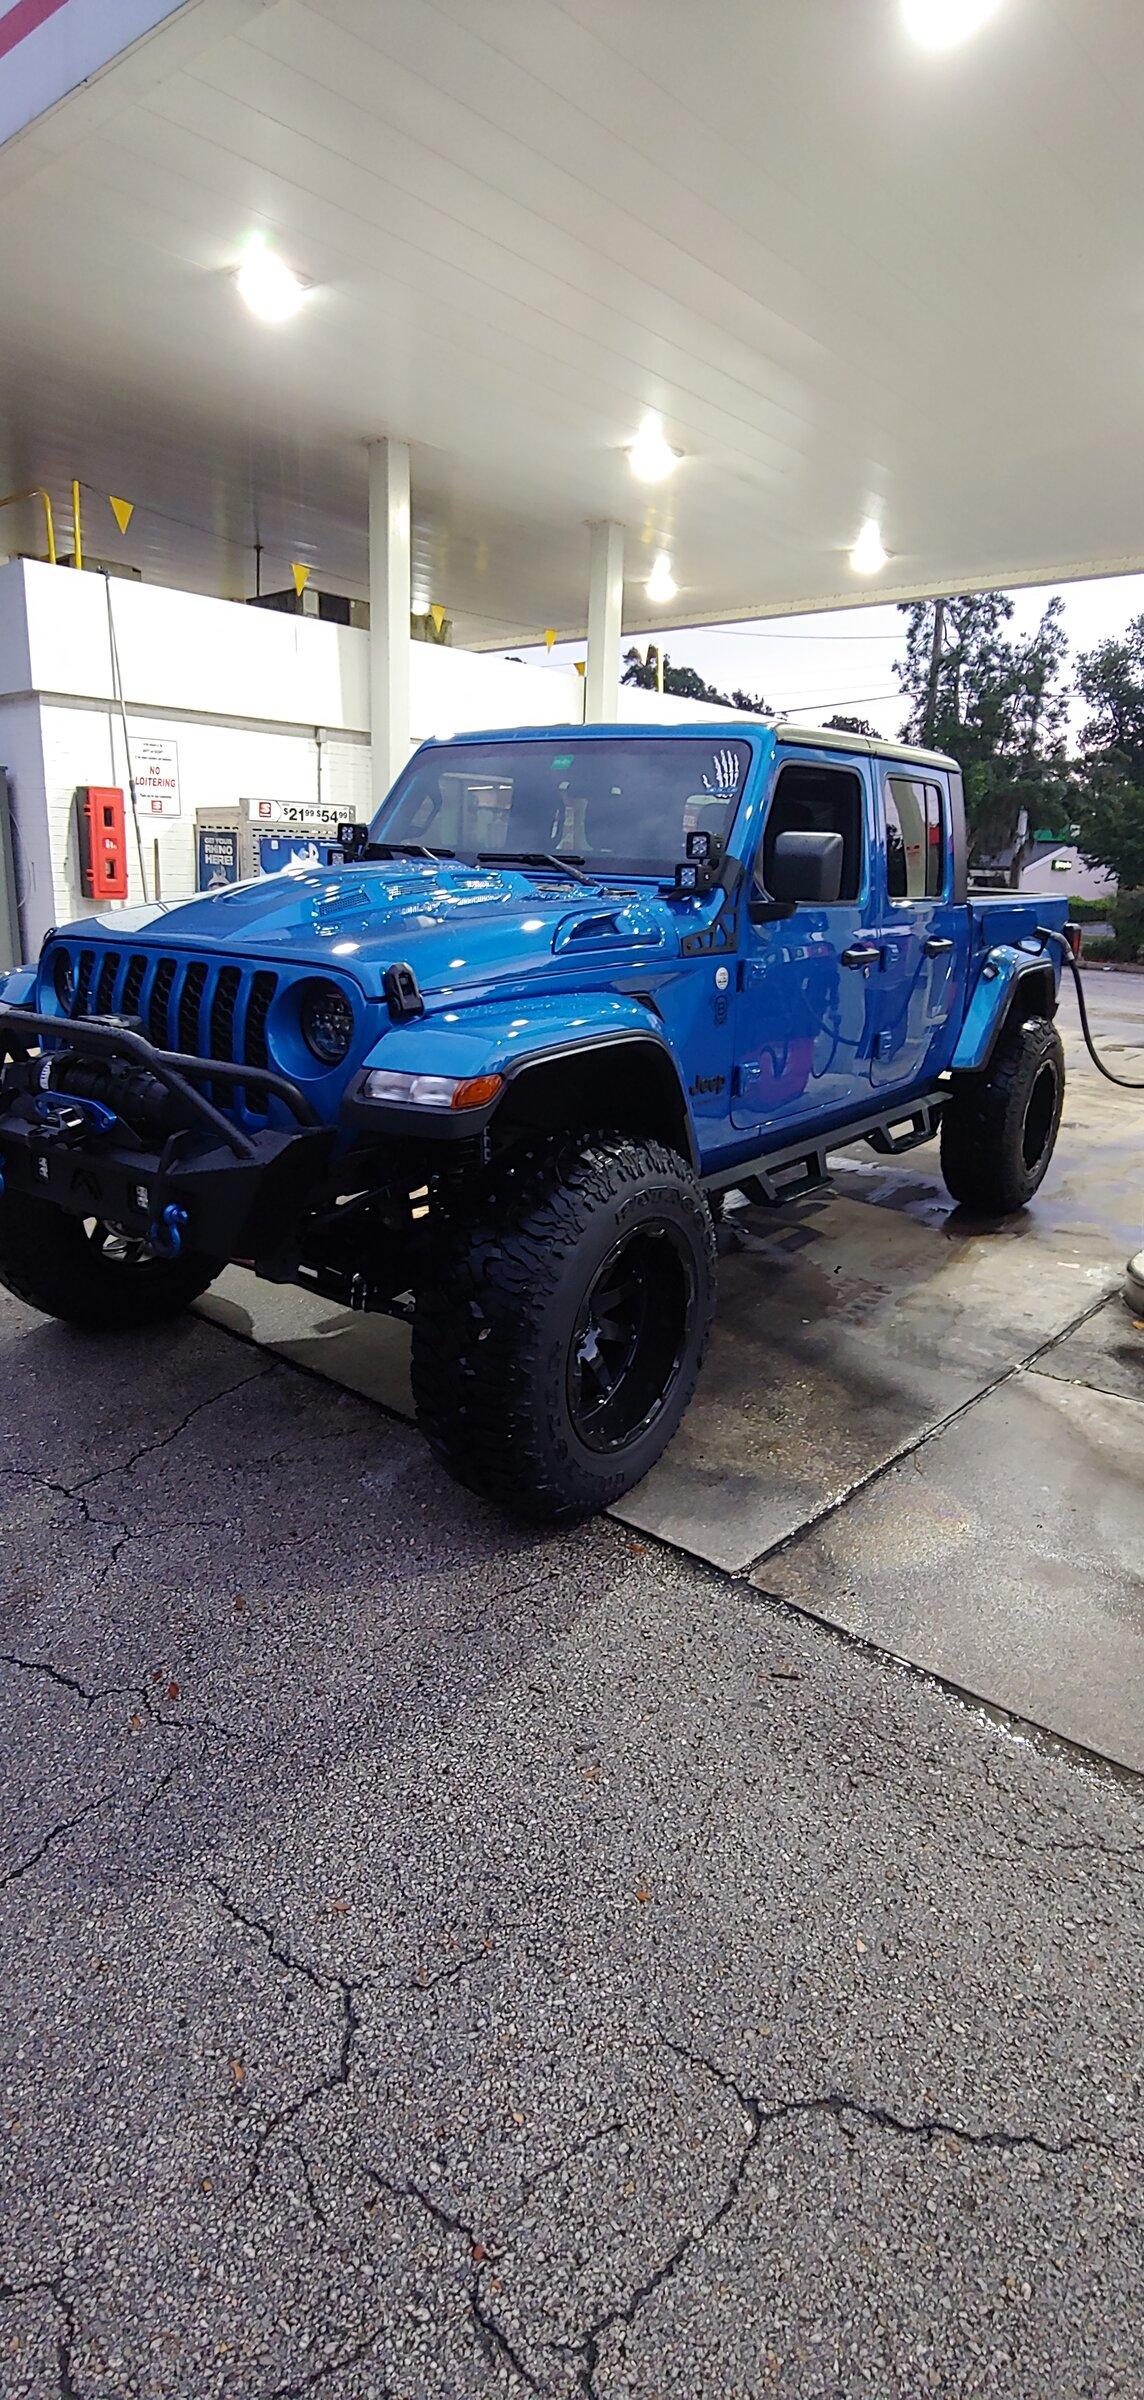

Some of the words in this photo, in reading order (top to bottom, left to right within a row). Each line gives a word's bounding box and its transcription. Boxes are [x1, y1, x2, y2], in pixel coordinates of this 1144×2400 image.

[149, 765, 161, 776] NO
[135, 776, 176, 788] LOITERING
[204, 844, 233, 855] RHINO
[204, 854, 234, 866] HERE!
[688, 1074, 725, 1097] Jeep
